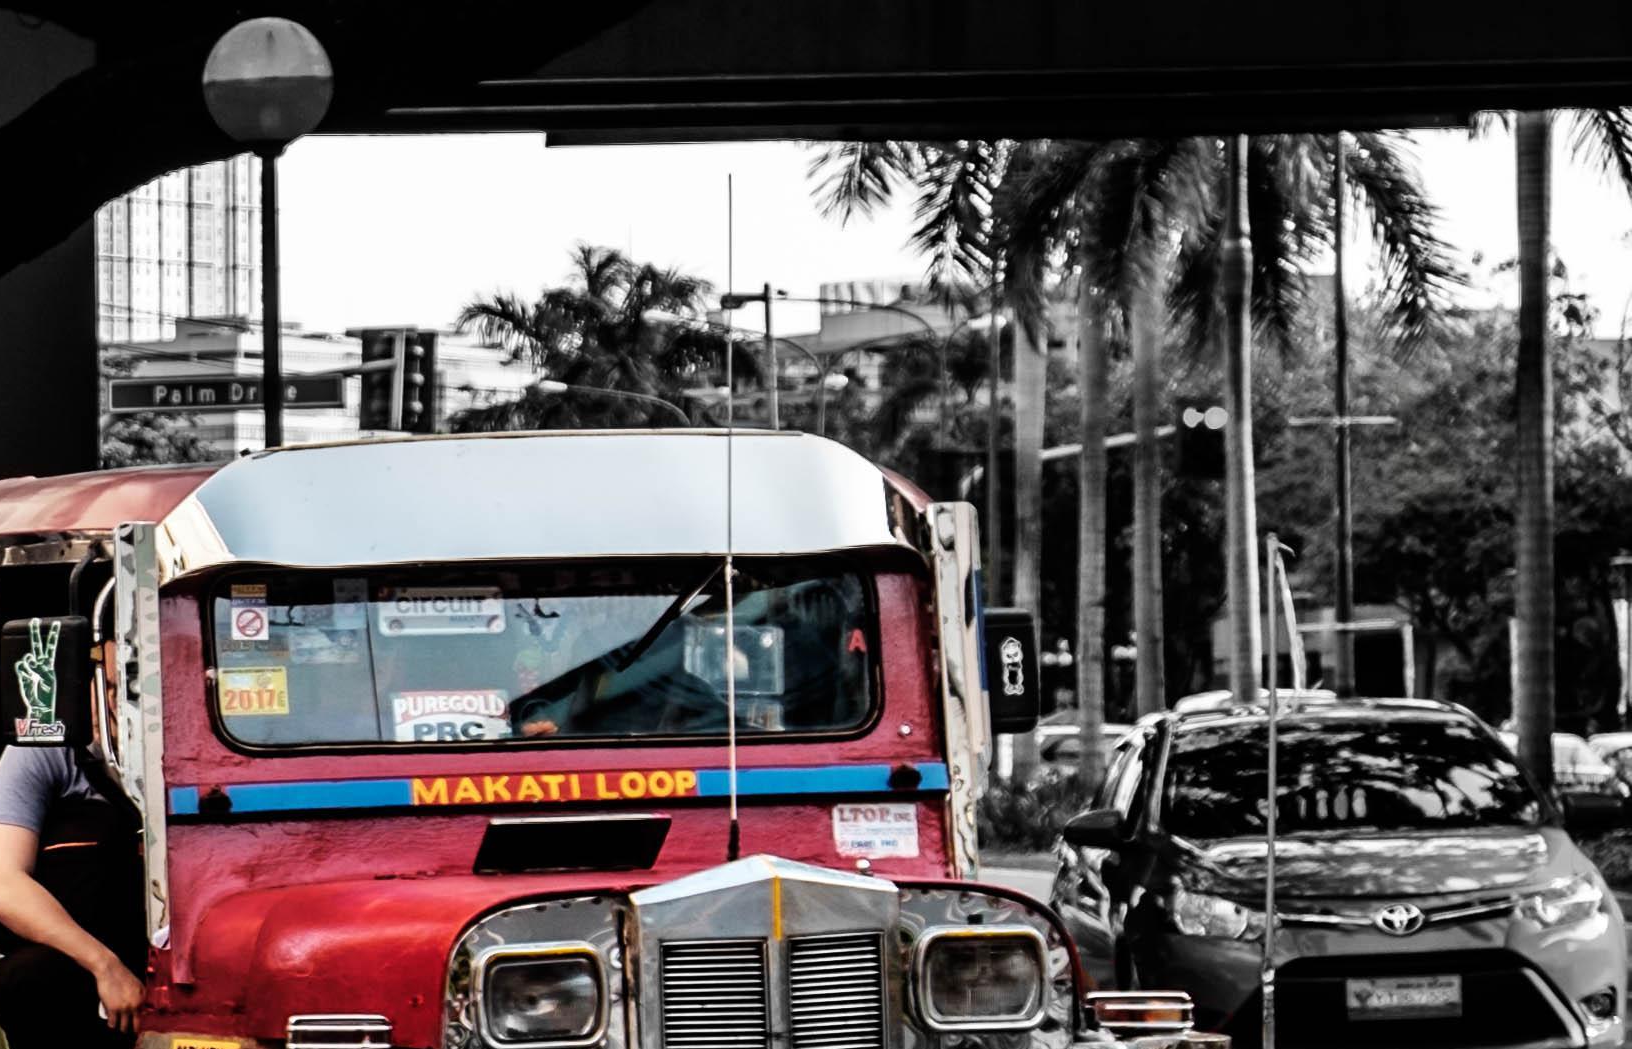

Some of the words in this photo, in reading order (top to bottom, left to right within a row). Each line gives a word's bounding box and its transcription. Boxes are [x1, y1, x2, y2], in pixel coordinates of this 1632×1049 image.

[154, 384, 215, 403] Palm
[231, 383, 297, 400] Dre
[224, 689, 276, 711] 2017
[394, 694, 506, 718] PUREGOLD
[412, 774, 581, 805] MAKATI
[596, 770, 696, 799] LOOP
